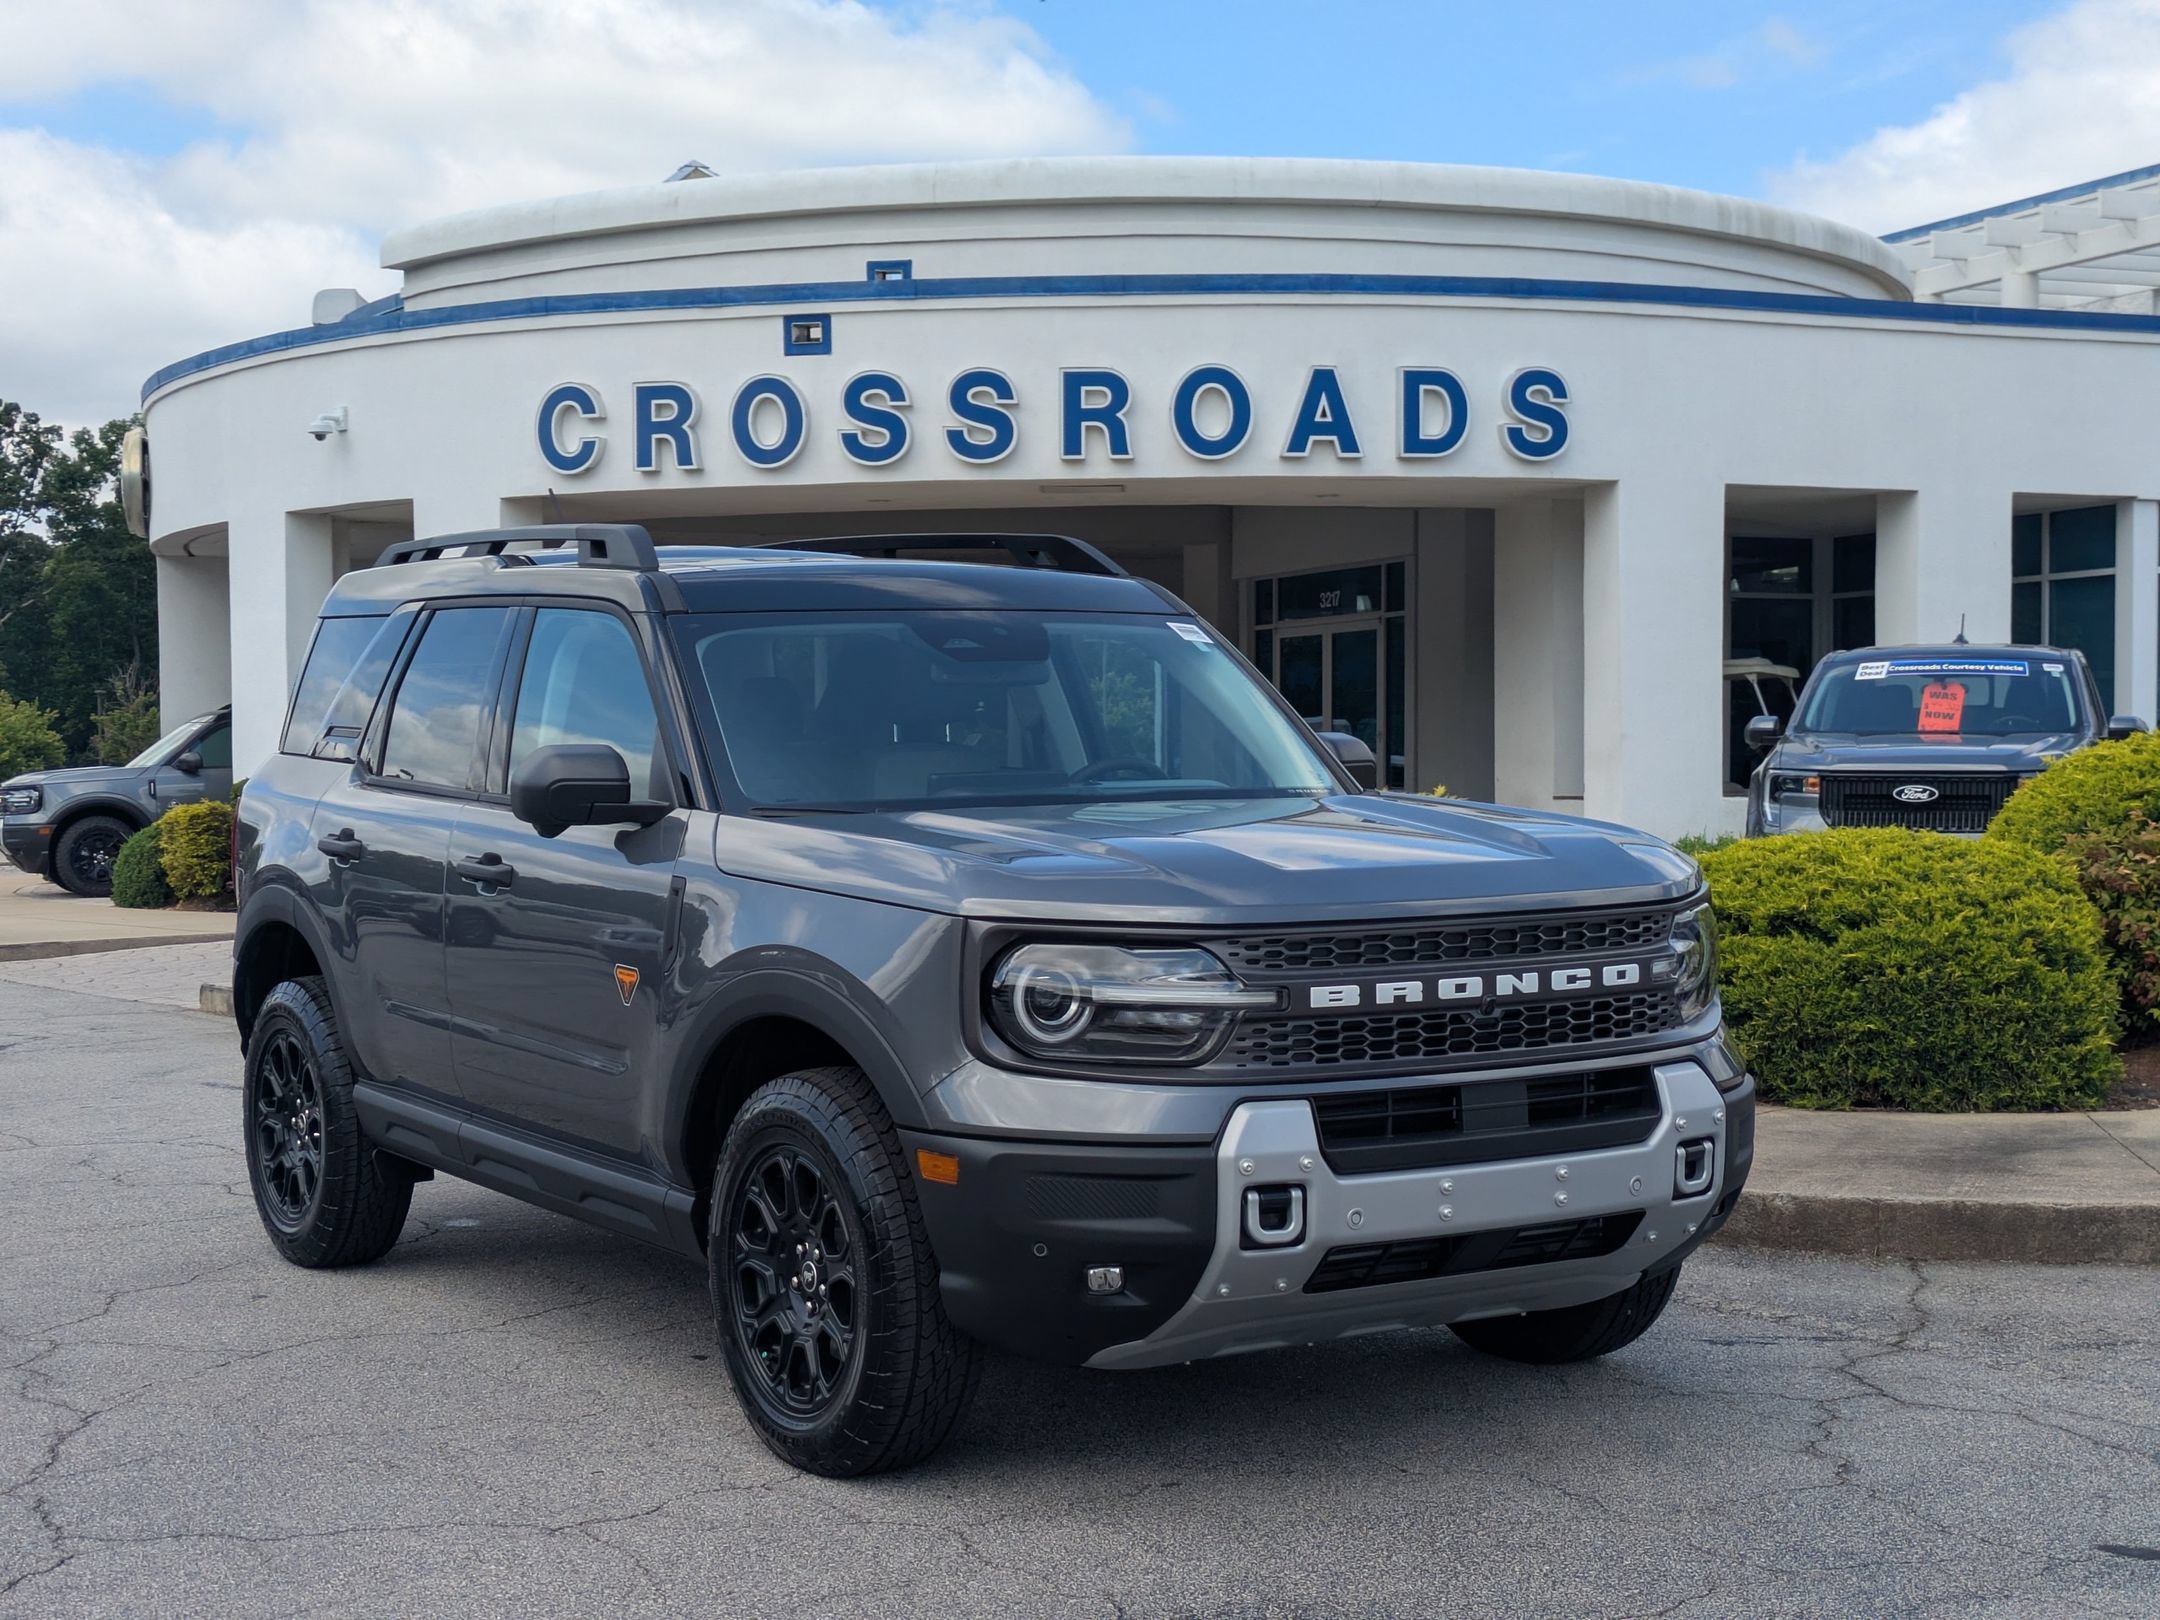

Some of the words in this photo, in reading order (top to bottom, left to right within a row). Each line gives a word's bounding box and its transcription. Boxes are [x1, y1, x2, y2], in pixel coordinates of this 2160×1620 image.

[535, 364, 1573, 476] CROSSROADS
[1320, 590, 1341, 608] 3217
[1888, 664, 1941, 672] Crossroads
[1942, 663, 1986, 672] Courtesy
[1987, 664, 2024, 672] Vehicle
[1929, 691, 1958, 701] WAS
[1924, 710, 1955, 720] NOW
[1901, 787, 1931, 799] Ford
[1310, 963, 1640, 1008] BRONCO
